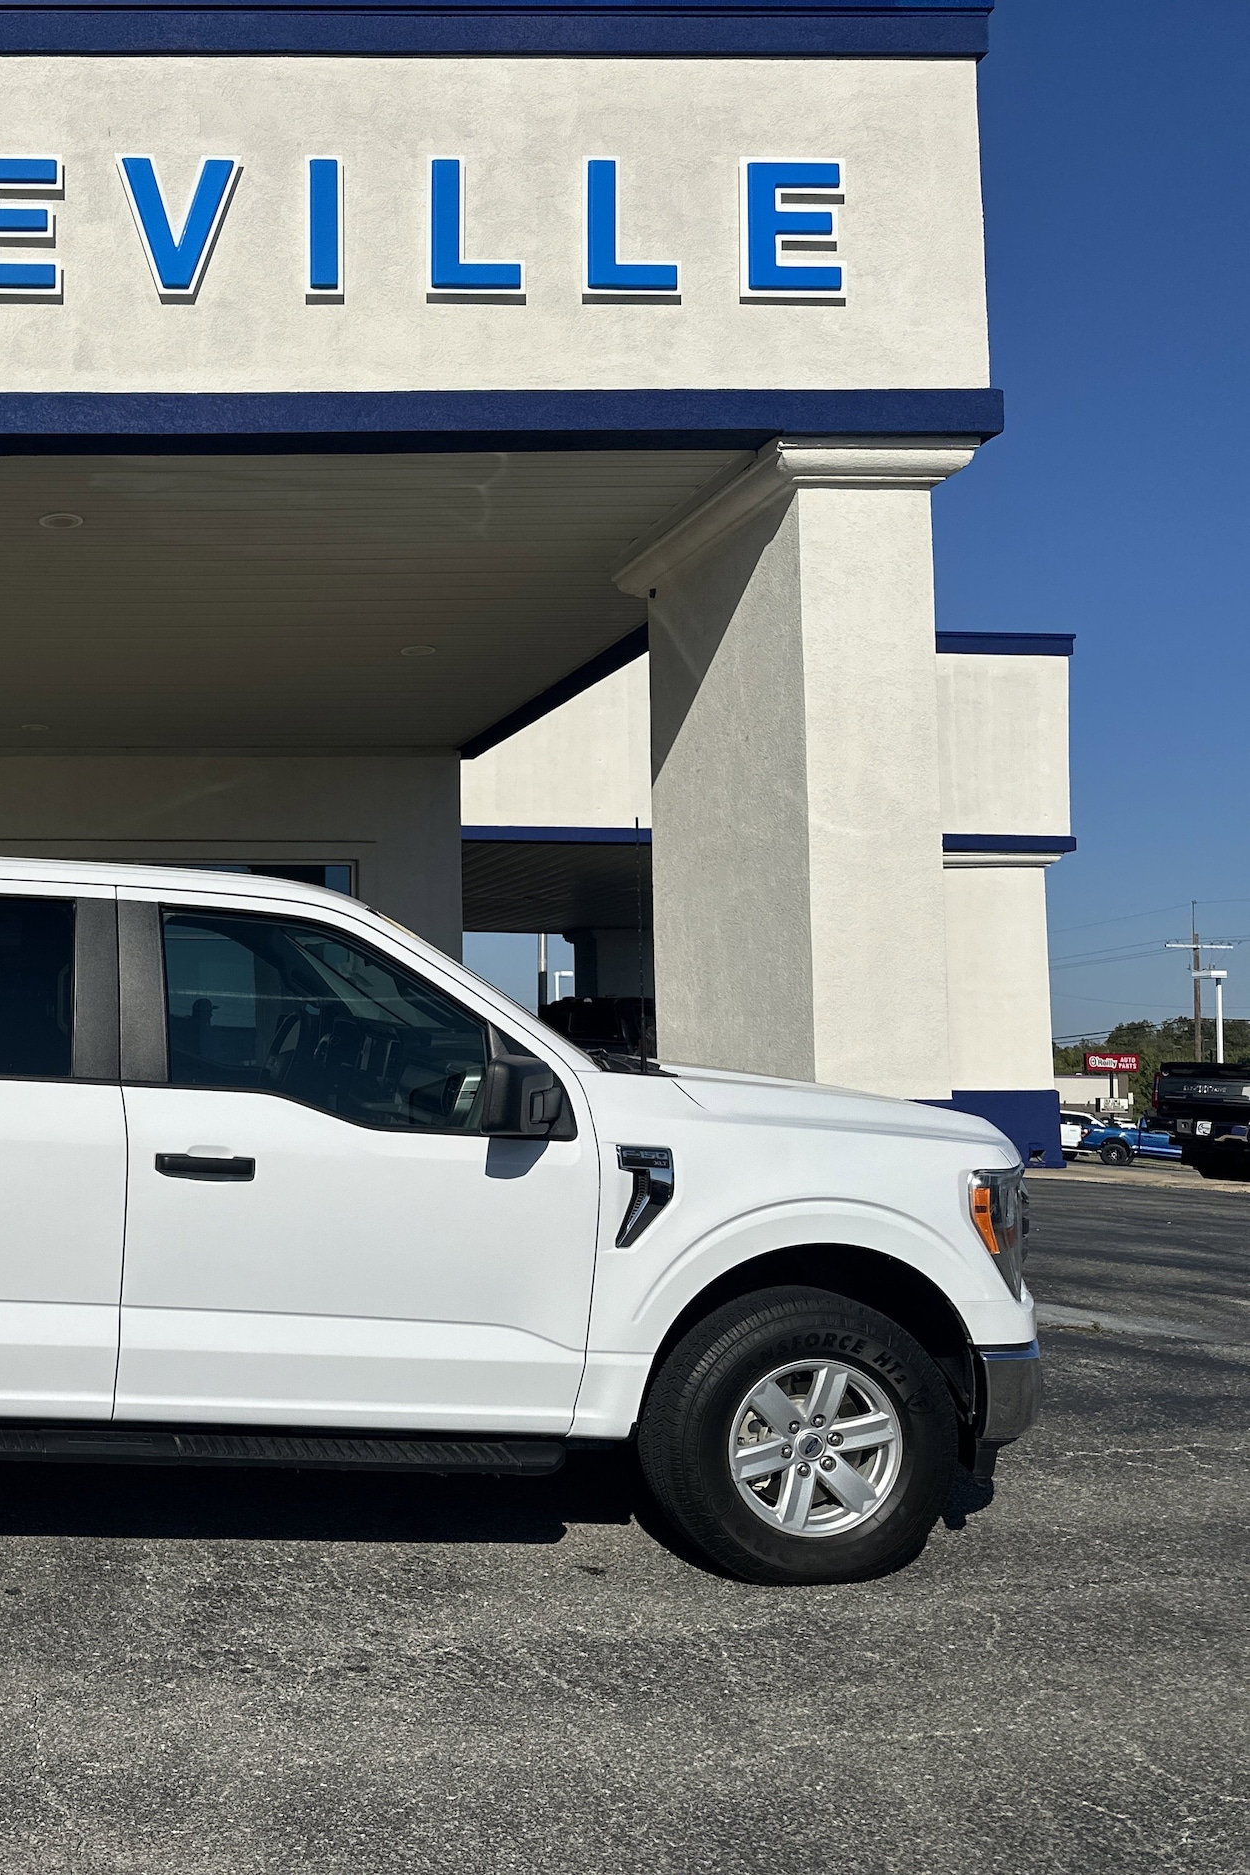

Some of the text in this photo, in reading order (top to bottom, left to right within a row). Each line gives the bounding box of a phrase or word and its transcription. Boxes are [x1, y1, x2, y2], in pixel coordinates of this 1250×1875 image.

[1089, 1056, 1118, 1068] O'Reilly
[622, 1150, 669, 1160] F-150
[872, 1353, 907, 1386] HT2
